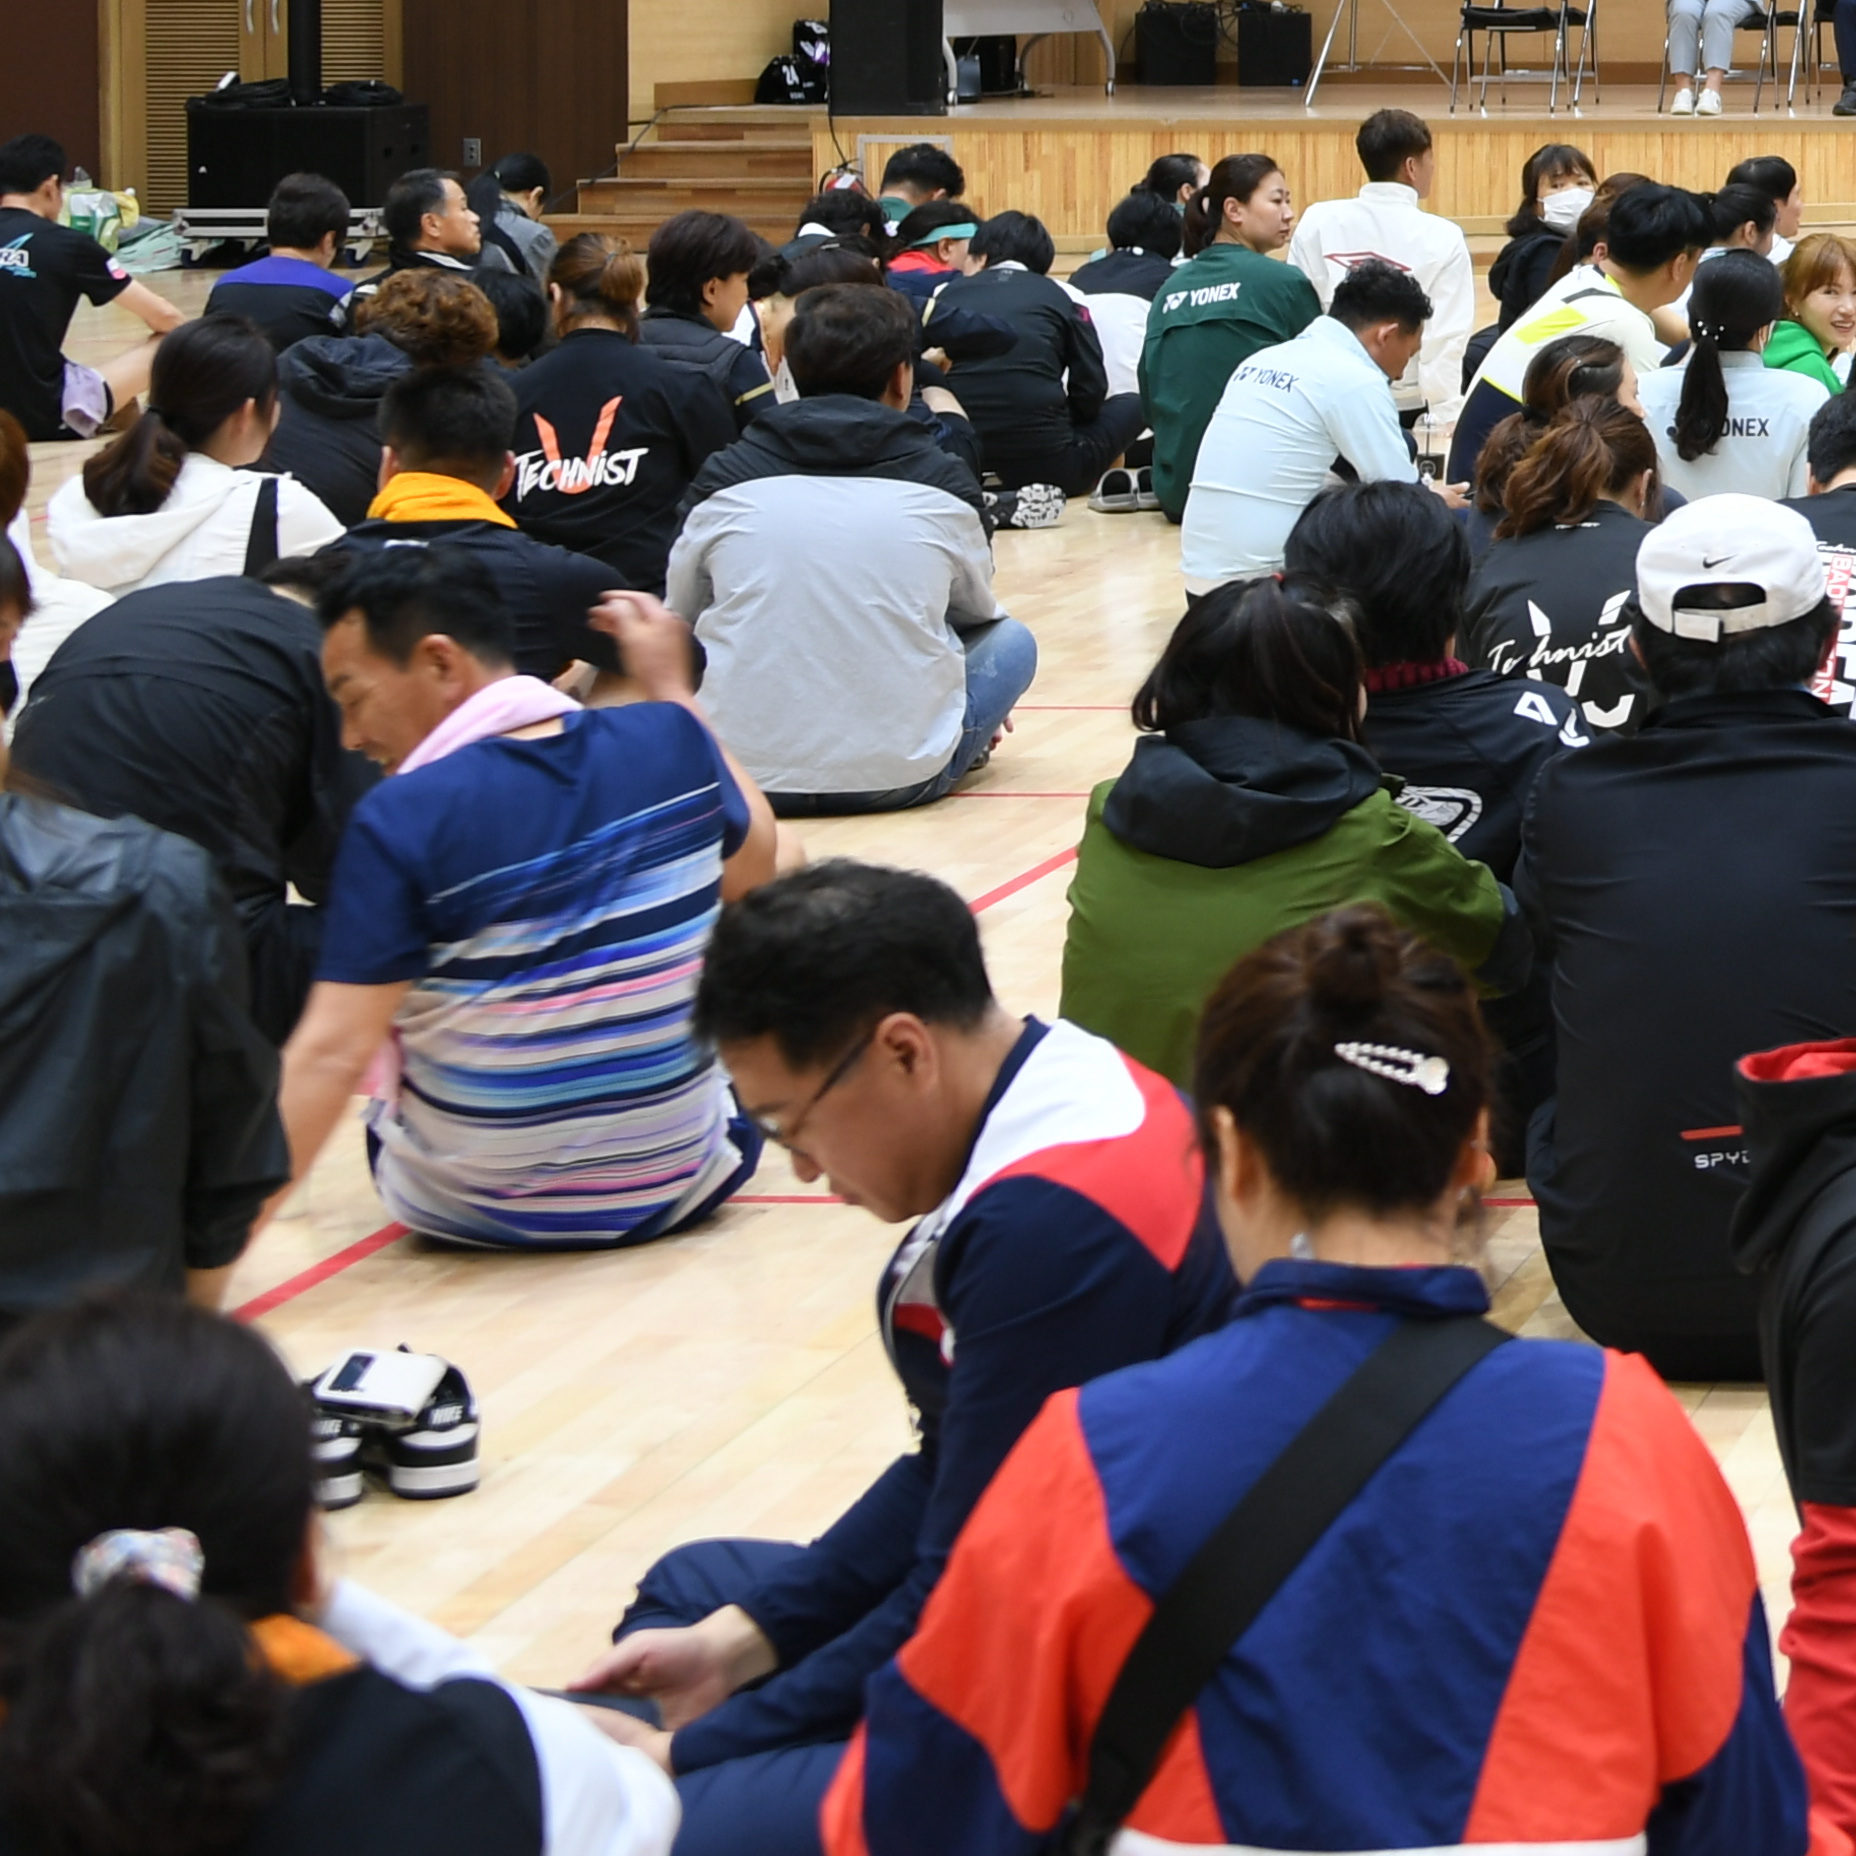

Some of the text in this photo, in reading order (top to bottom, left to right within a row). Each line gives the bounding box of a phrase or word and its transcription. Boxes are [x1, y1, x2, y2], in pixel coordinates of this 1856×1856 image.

[1190, 282, 1242, 307] YONEX
[1253, 368, 1300, 394] YONEX
[1487, 624, 1632, 675] Tehnist
